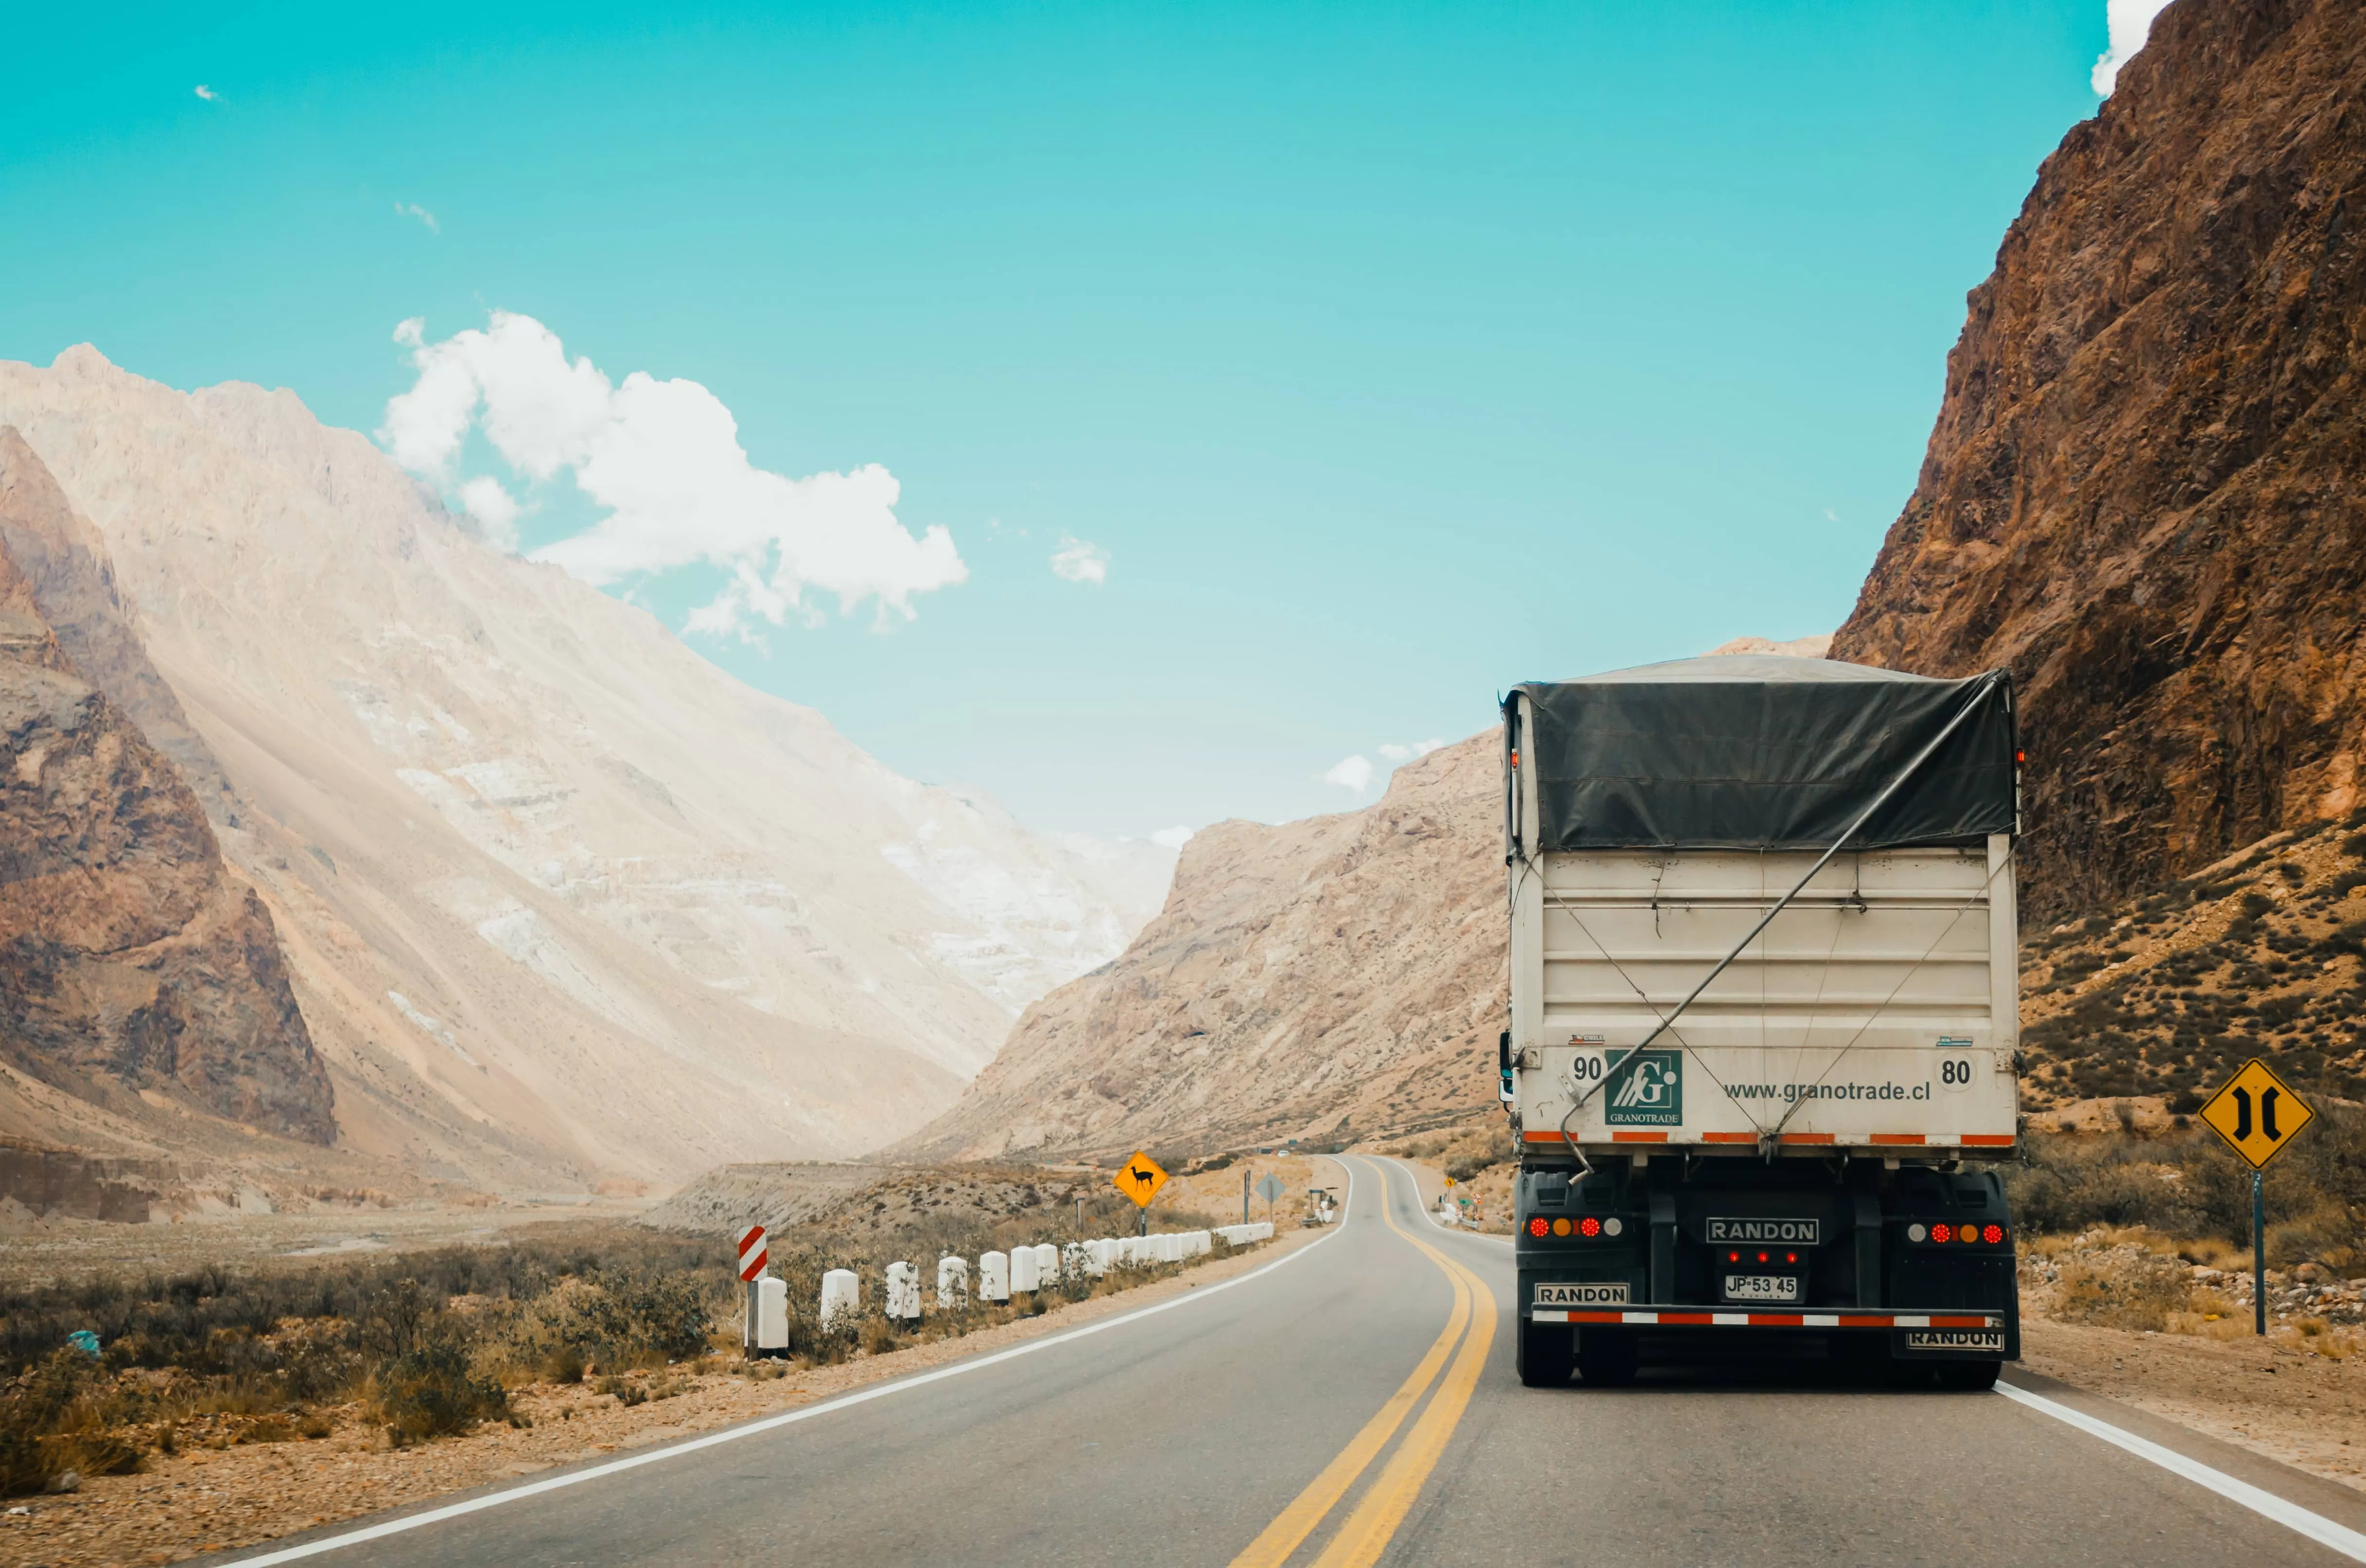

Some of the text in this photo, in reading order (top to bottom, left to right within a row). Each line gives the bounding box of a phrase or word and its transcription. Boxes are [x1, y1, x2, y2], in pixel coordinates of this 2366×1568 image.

[1574, 1056, 1601, 1080] 90
[1942, 1060, 1970, 1084] 80
[1724, 1081, 1930, 1103] www.granotrade.cl
[1610, 1114, 1678, 1123] GRANOTRADE
[1711, 1223, 1814, 1240] RANDON
[1752, 1278, 1771, 1292] 53
[1776, 1279, 1795, 1293] 45
[1541, 1288, 1625, 1302] RANDON
[1911, 1333, 1999, 1345] RANDON
